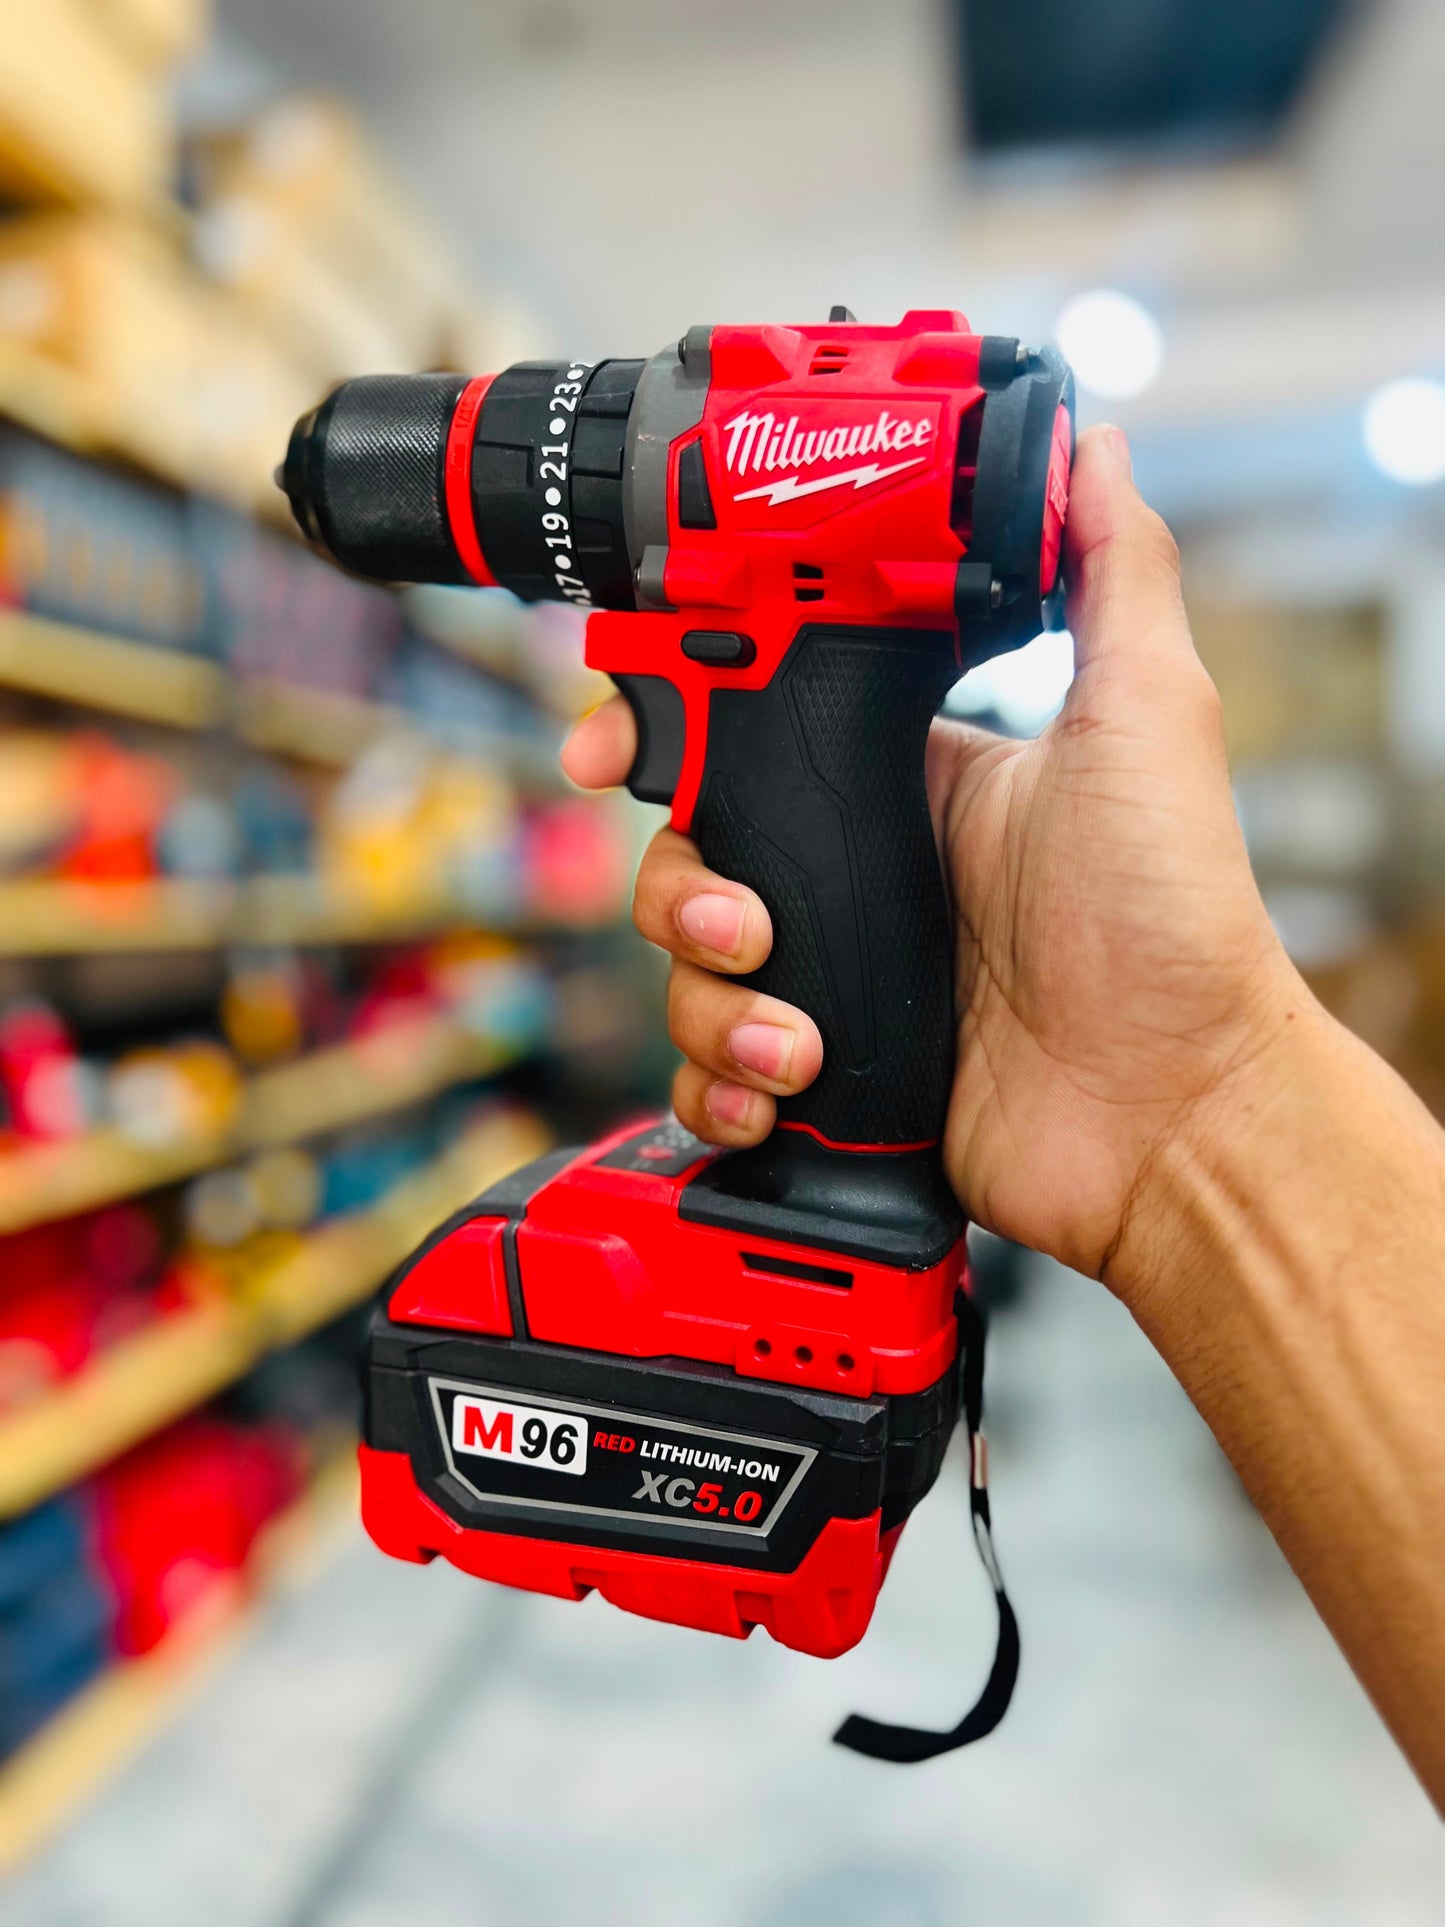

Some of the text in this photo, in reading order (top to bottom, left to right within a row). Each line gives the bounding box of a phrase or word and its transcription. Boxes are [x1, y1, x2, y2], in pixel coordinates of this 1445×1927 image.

[723, 411, 932, 477] Milwaukee
[540, 382, 591, 598] 17 19 21 23
[463, 1405, 579, 1465] M96
[593, 1431, 780, 1482] RED LITHIUM-ION
[632, 1470, 763, 1521] XC5.0
